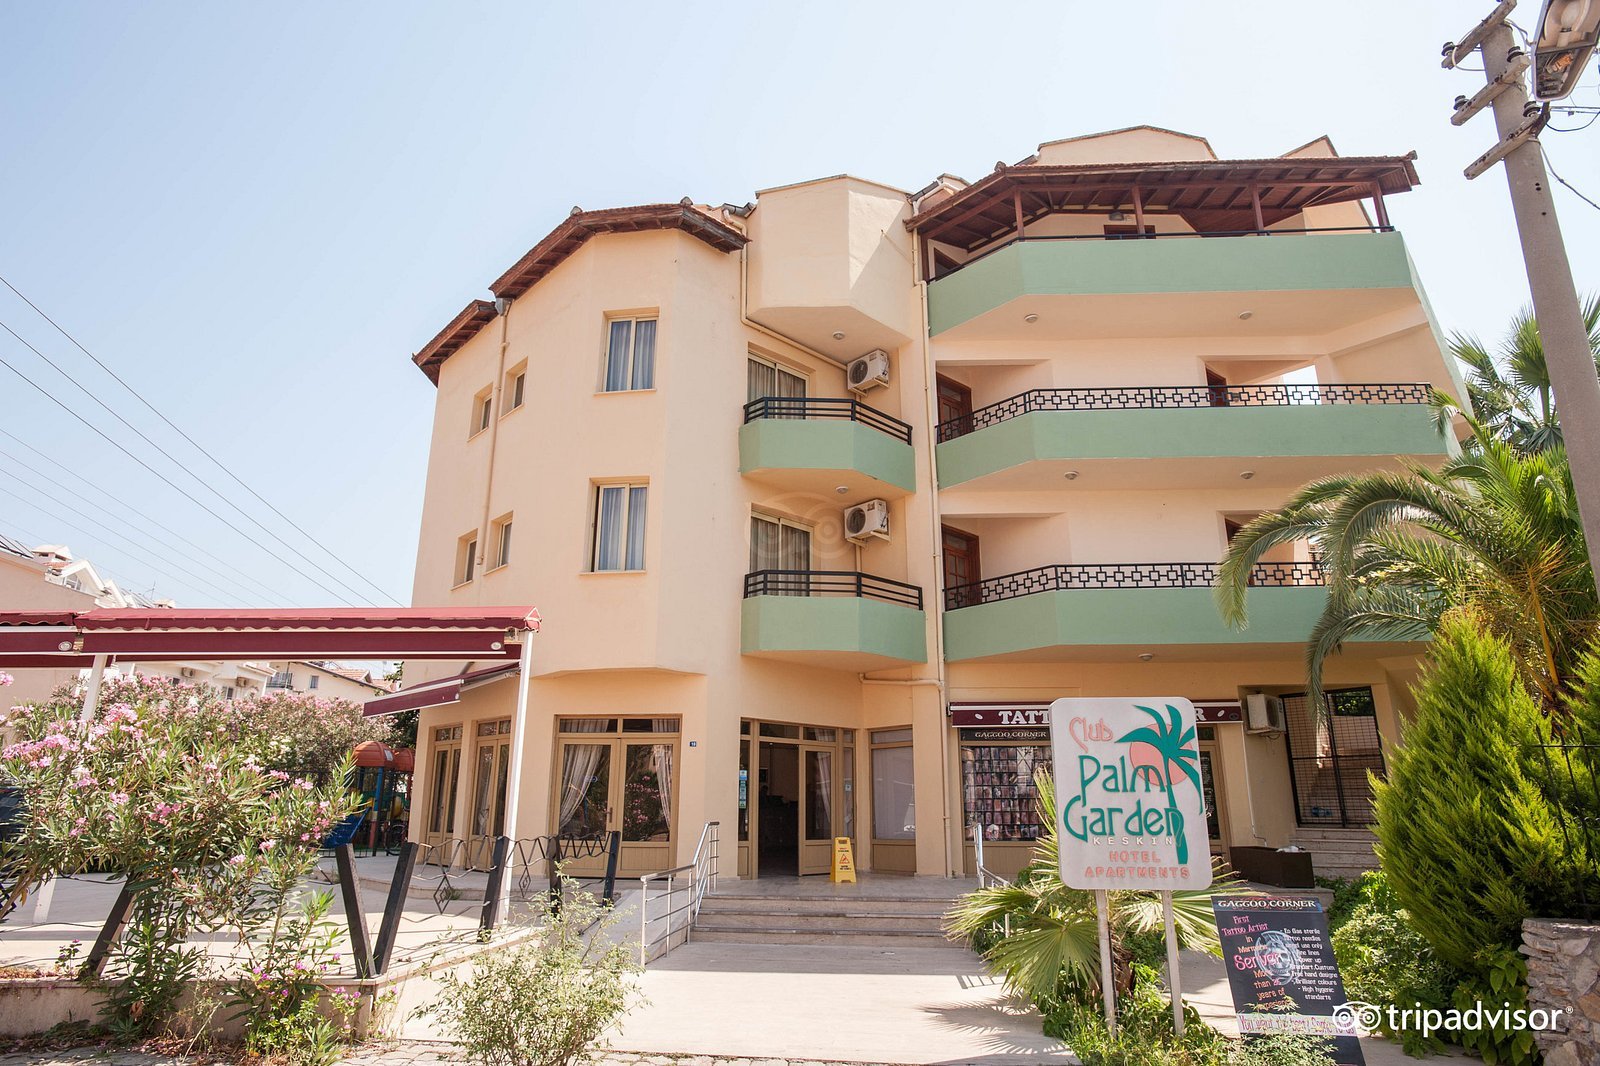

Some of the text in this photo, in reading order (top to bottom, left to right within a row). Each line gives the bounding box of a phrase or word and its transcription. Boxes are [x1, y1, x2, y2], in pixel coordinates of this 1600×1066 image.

[998, 710, 1050, 725] TATT
[1069, 716, 1113, 753] Club
[1078, 754, 1168, 808] Palm
[1063, 798, 1185, 847] Garden
[1093, 837, 1173, 846] KESKIN
[1109, 850, 1162, 864] HOTEL
[1084, 866, 1191, 880] APARTMENTS
[1269, 900, 1317, 909] CORNER
